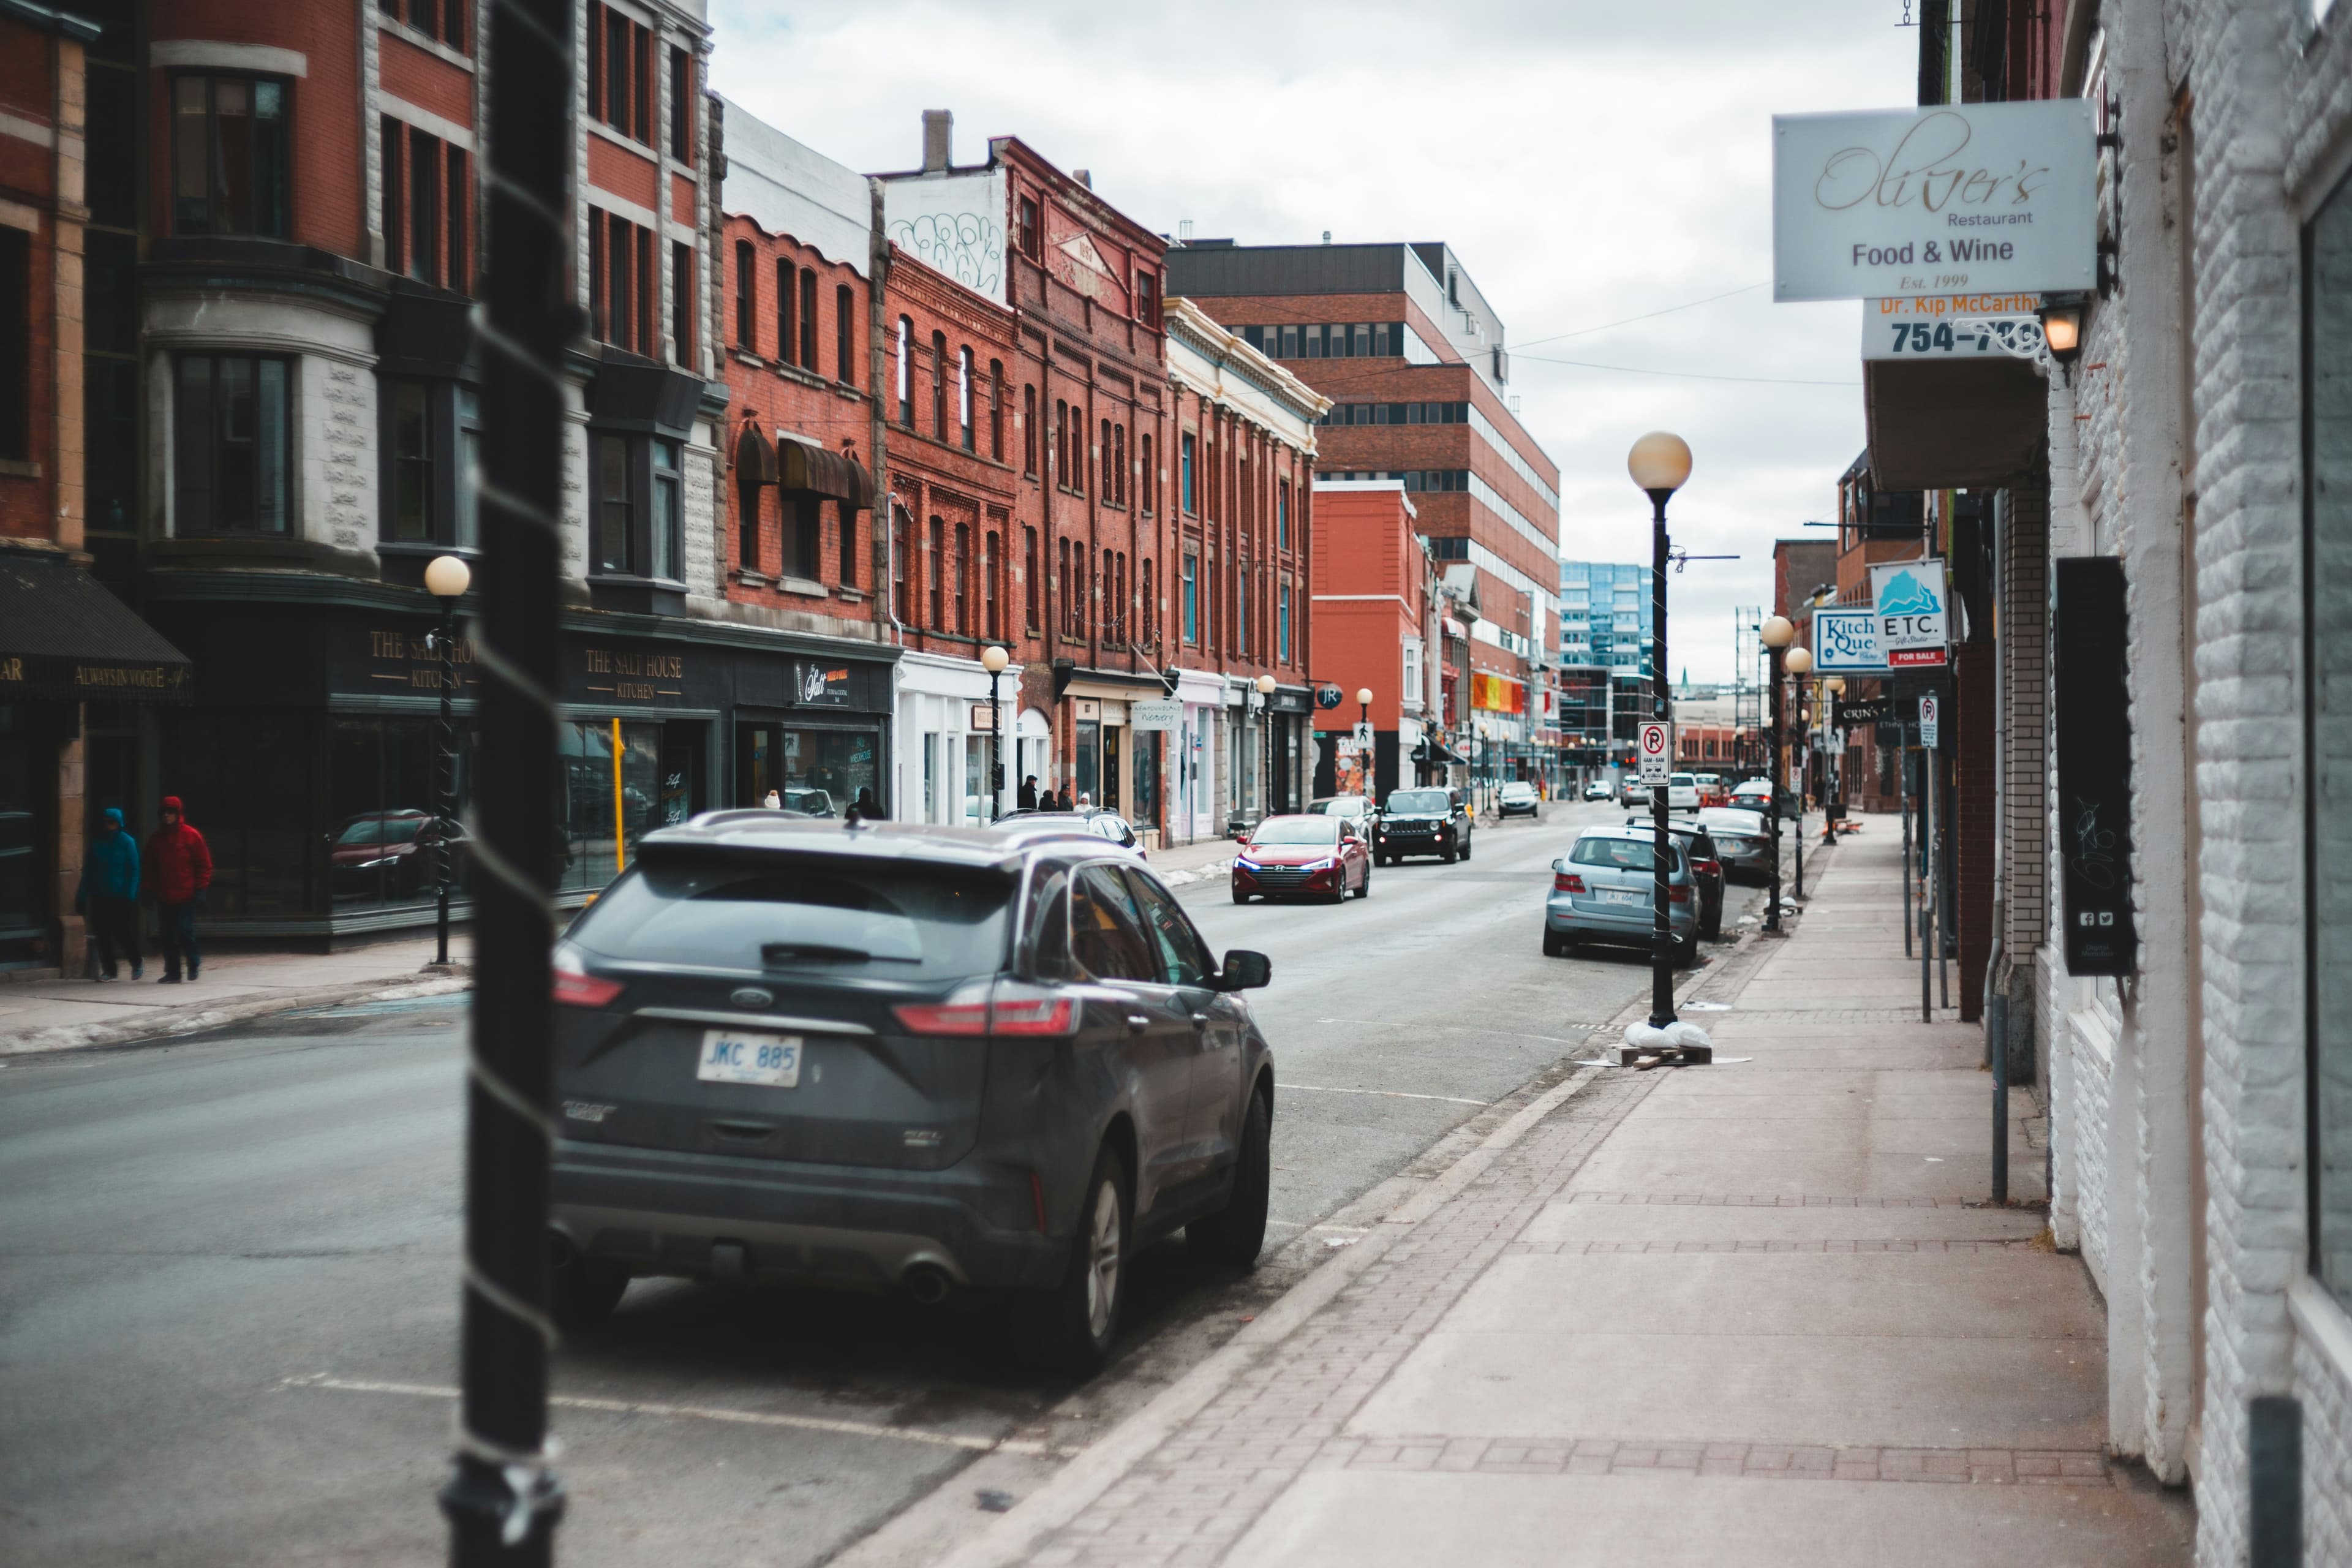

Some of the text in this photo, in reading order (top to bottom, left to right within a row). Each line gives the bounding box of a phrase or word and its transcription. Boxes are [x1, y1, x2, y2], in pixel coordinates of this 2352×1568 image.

[1815, 111, 2049, 213] Oliver's
[1948, 212, 2033, 227] Restaurant
[1853, 239, 2014, 266] Food & Wine
[1899, 274, 1969, 290] Est. 1999
[1880, 296, 1909, 314] Dr.
[1915, 295, 1947, 317] Kip
[1826, 618, 1874, 639] Kitch
[1884, 616, 1938, 636] ETC.
[371, 631, 404, 659] THE
[1834, 635, 1877, 657] Que
[586, 649, 682, 679] THE SALT HOUSE
[617, 682, 655, 699] KITCHEN
[805, 668, 827, 702] Salt
[1324, 688, 1337, 704] JR
[1141, 713, 1174, 726] Weavery
[666, 772, 681, 789] $4
[666, 809, 681, 826] $4
[707, 1041, 795, 1071] JKC 885
